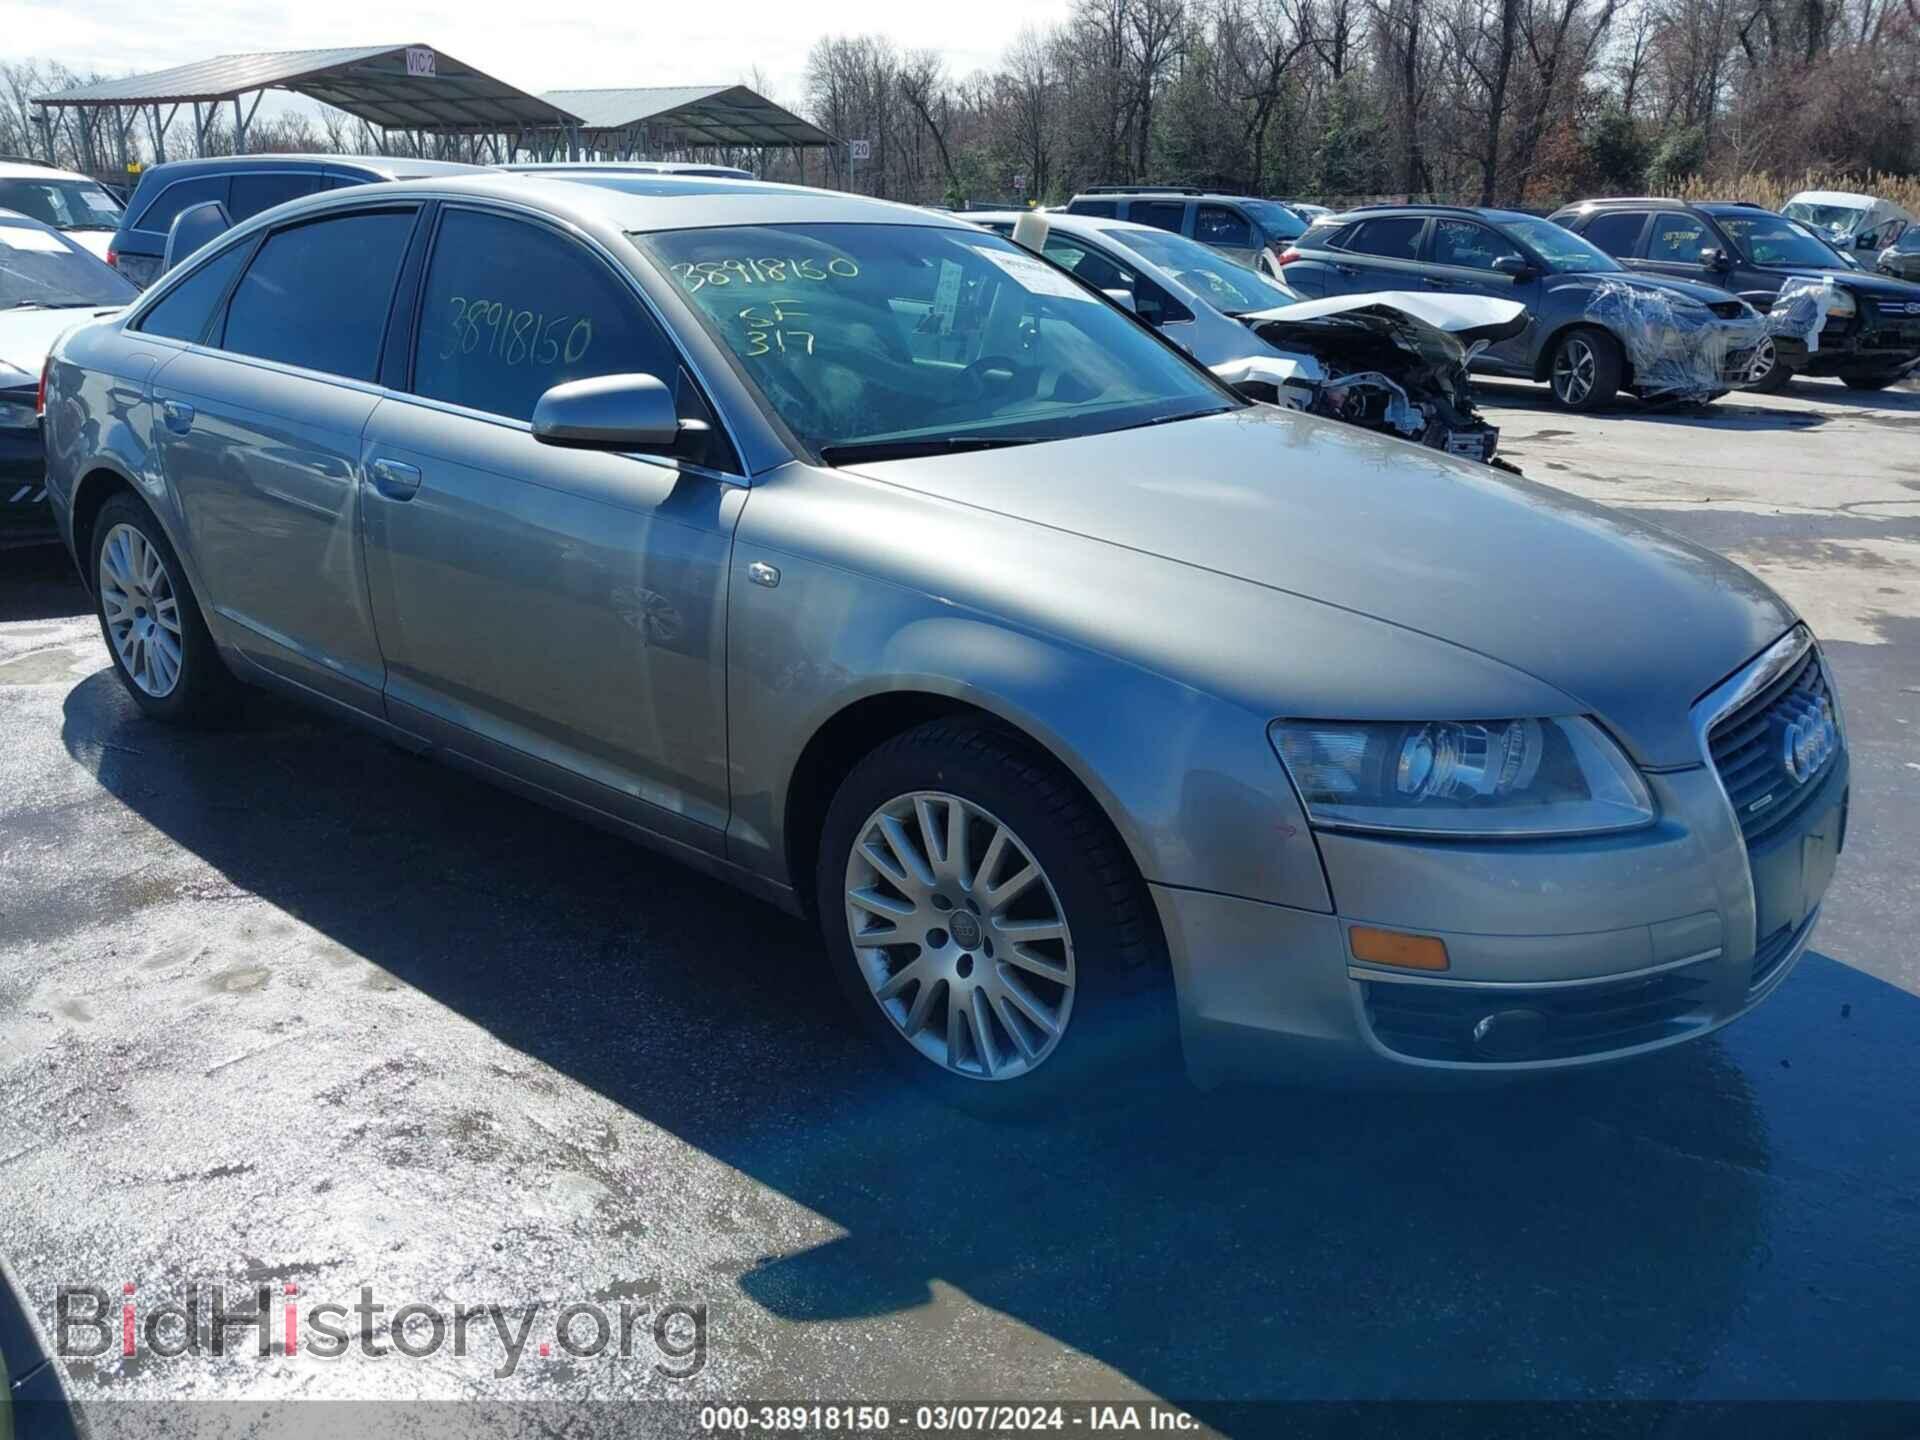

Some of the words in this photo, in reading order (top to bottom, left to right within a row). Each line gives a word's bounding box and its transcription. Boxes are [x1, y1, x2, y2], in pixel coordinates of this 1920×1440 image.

[854, 143, 868, 156] 20
[670, 257, 859, 293] 38918150
[439, 296, 593, 367] 38918150
[746, 329, 815, 356] 317
